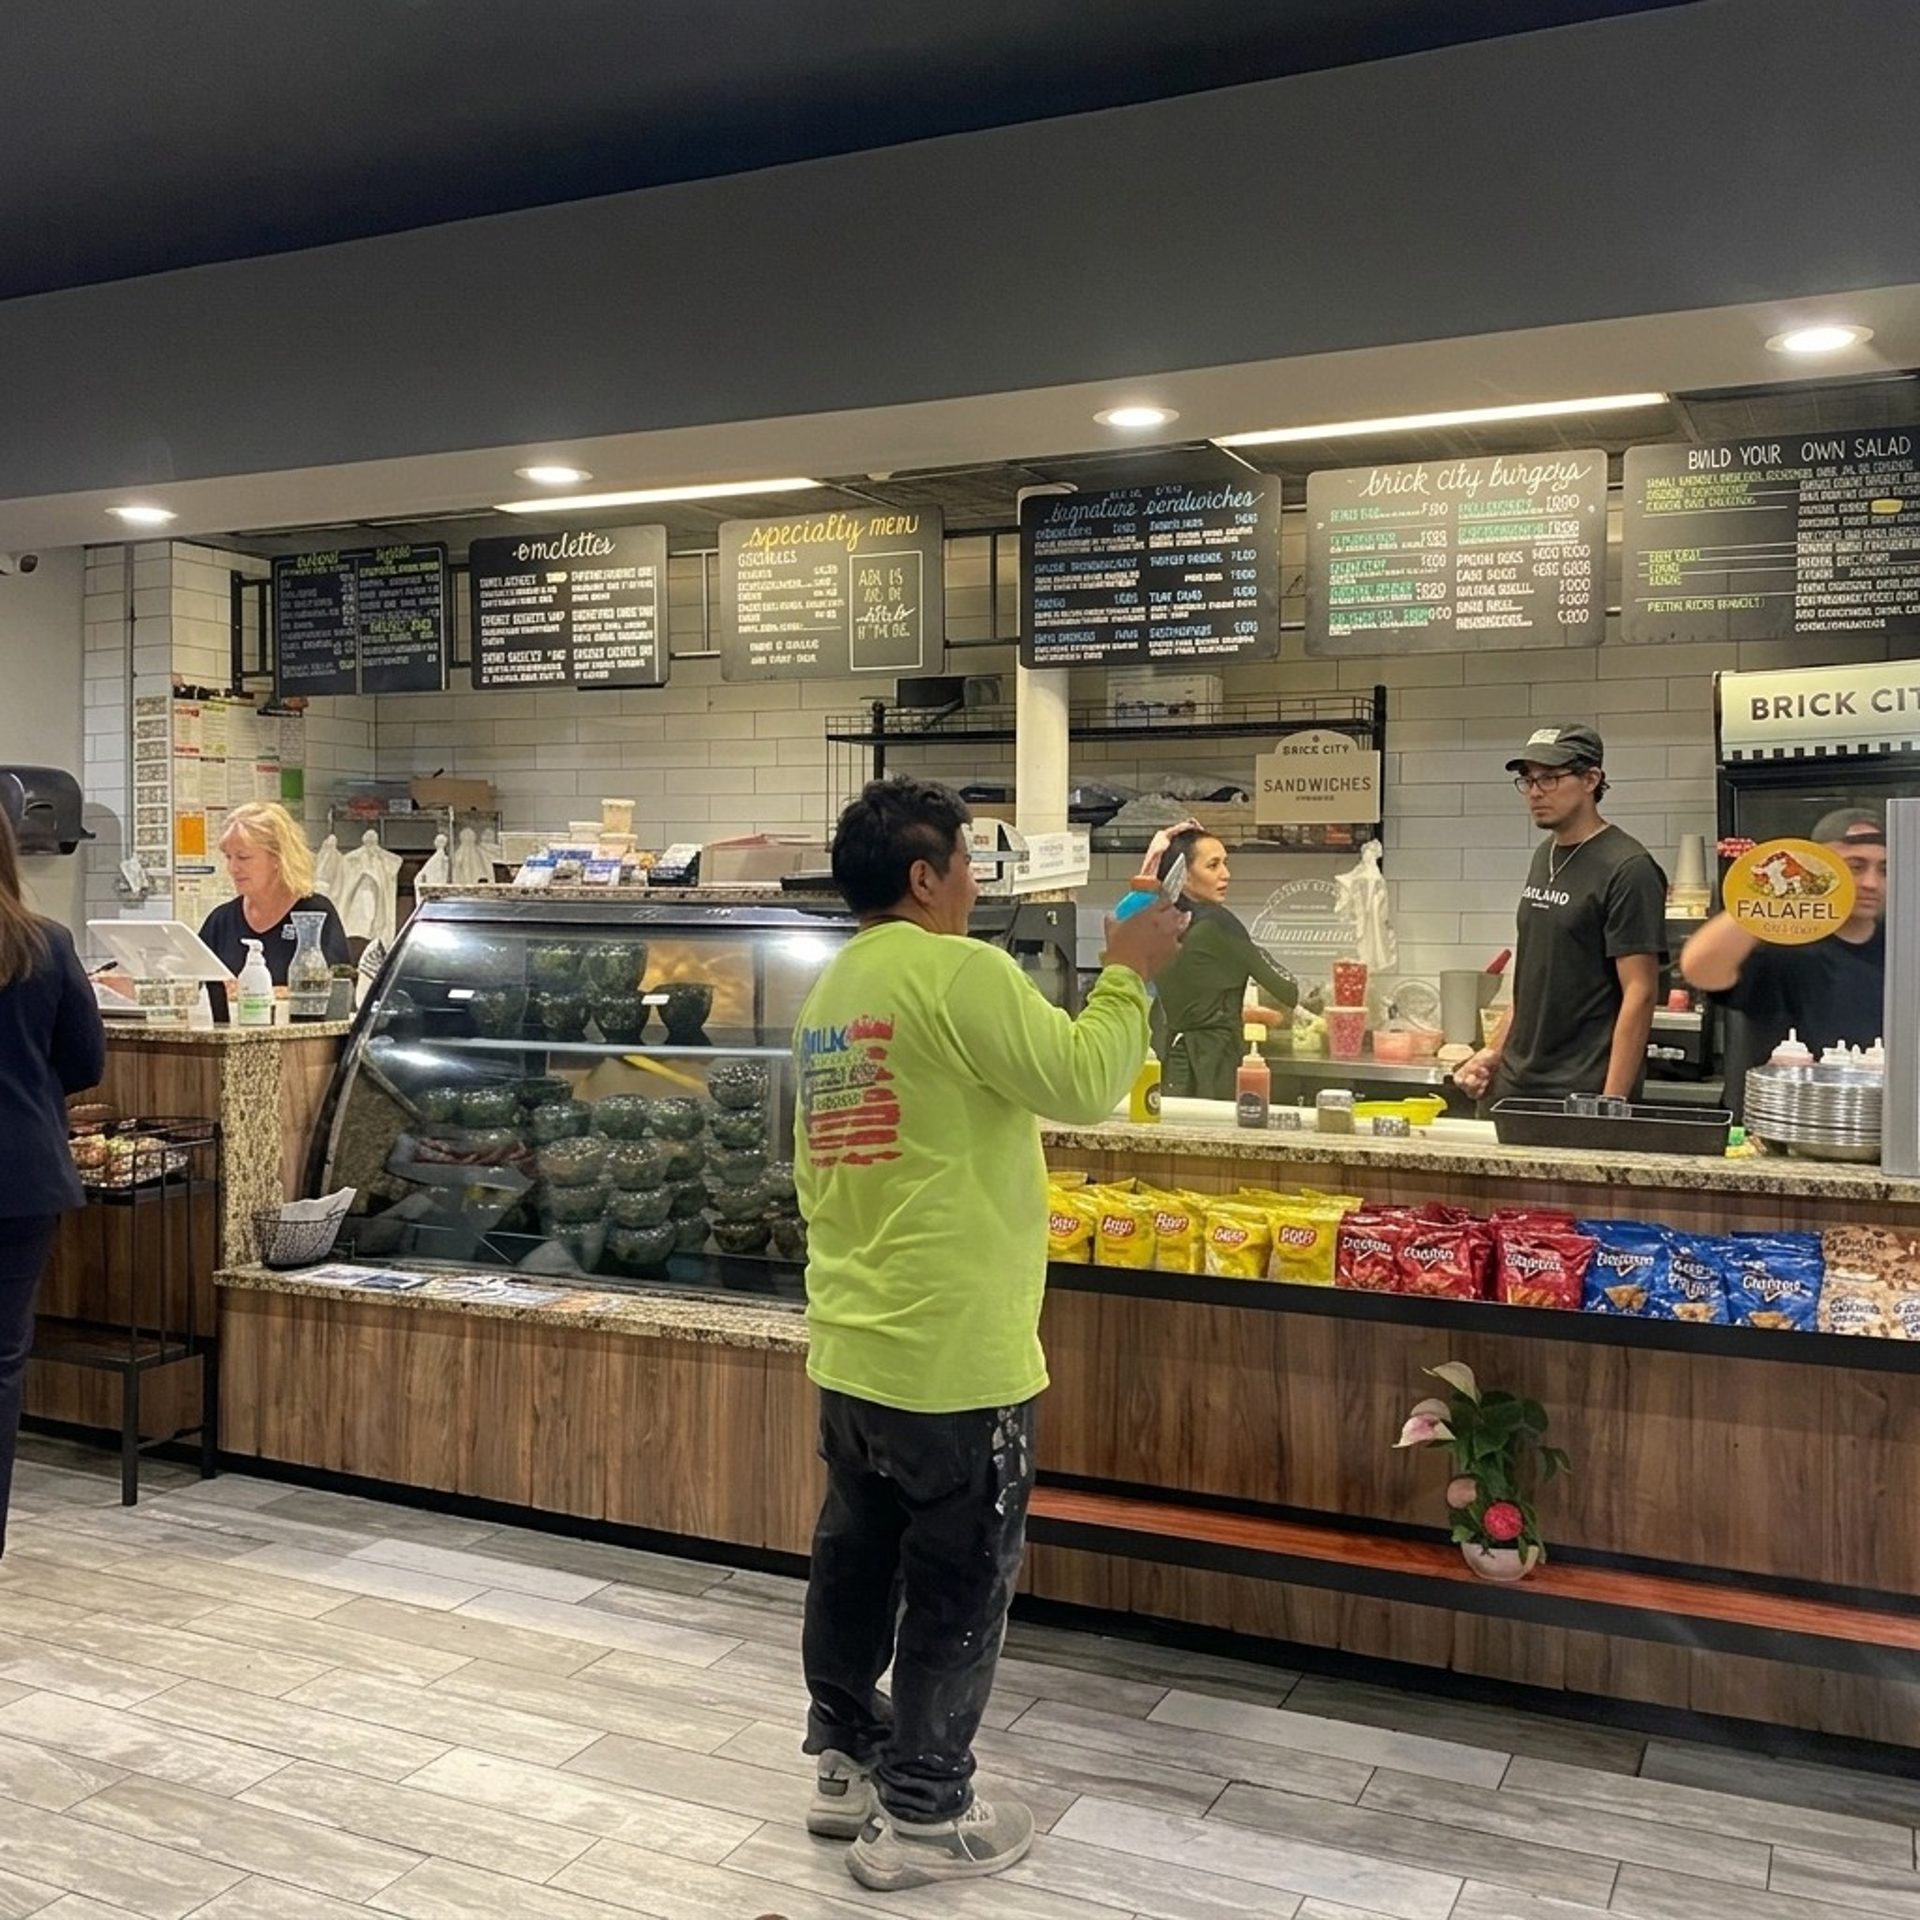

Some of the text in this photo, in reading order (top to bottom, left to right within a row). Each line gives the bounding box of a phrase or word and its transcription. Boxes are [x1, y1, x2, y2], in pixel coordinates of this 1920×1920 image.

[1739, 444, 1783, 466] YOUR
[1800, 440, 1846, 462] OWN
[1854, 436, 1912, 458] SALAD
[1359, 464, 1431, 498] brick
[1751, 691, 1857, 721] BRICK
[1282, 743, 1349, 756] BRICK CITY
[1263, 776, 1372, 793] SANDWICHES
[1737, 899, 1841, 920] FALAFEL
